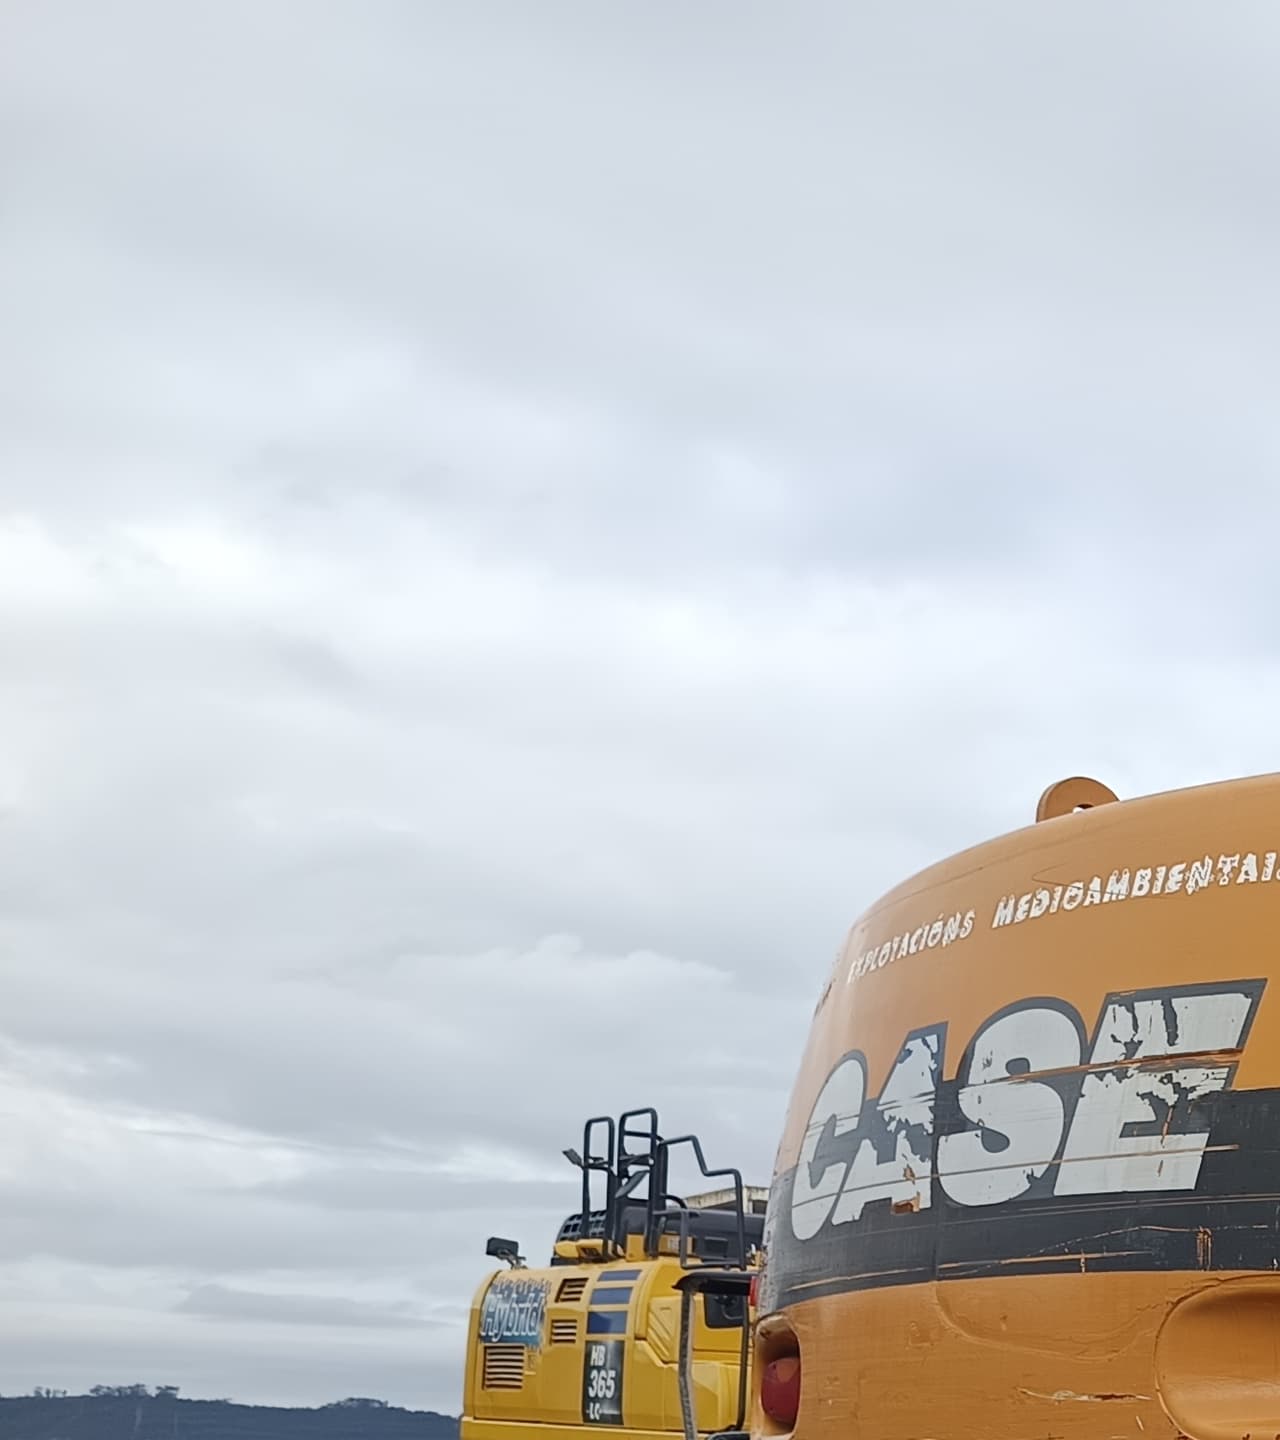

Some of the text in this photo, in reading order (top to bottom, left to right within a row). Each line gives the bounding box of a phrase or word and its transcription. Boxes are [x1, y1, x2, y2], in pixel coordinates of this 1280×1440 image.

[791, 988, 1254, 1241] CASE
[589, 1344, 606, 1367] HB
[588, 1368, 617, 1399] 365
